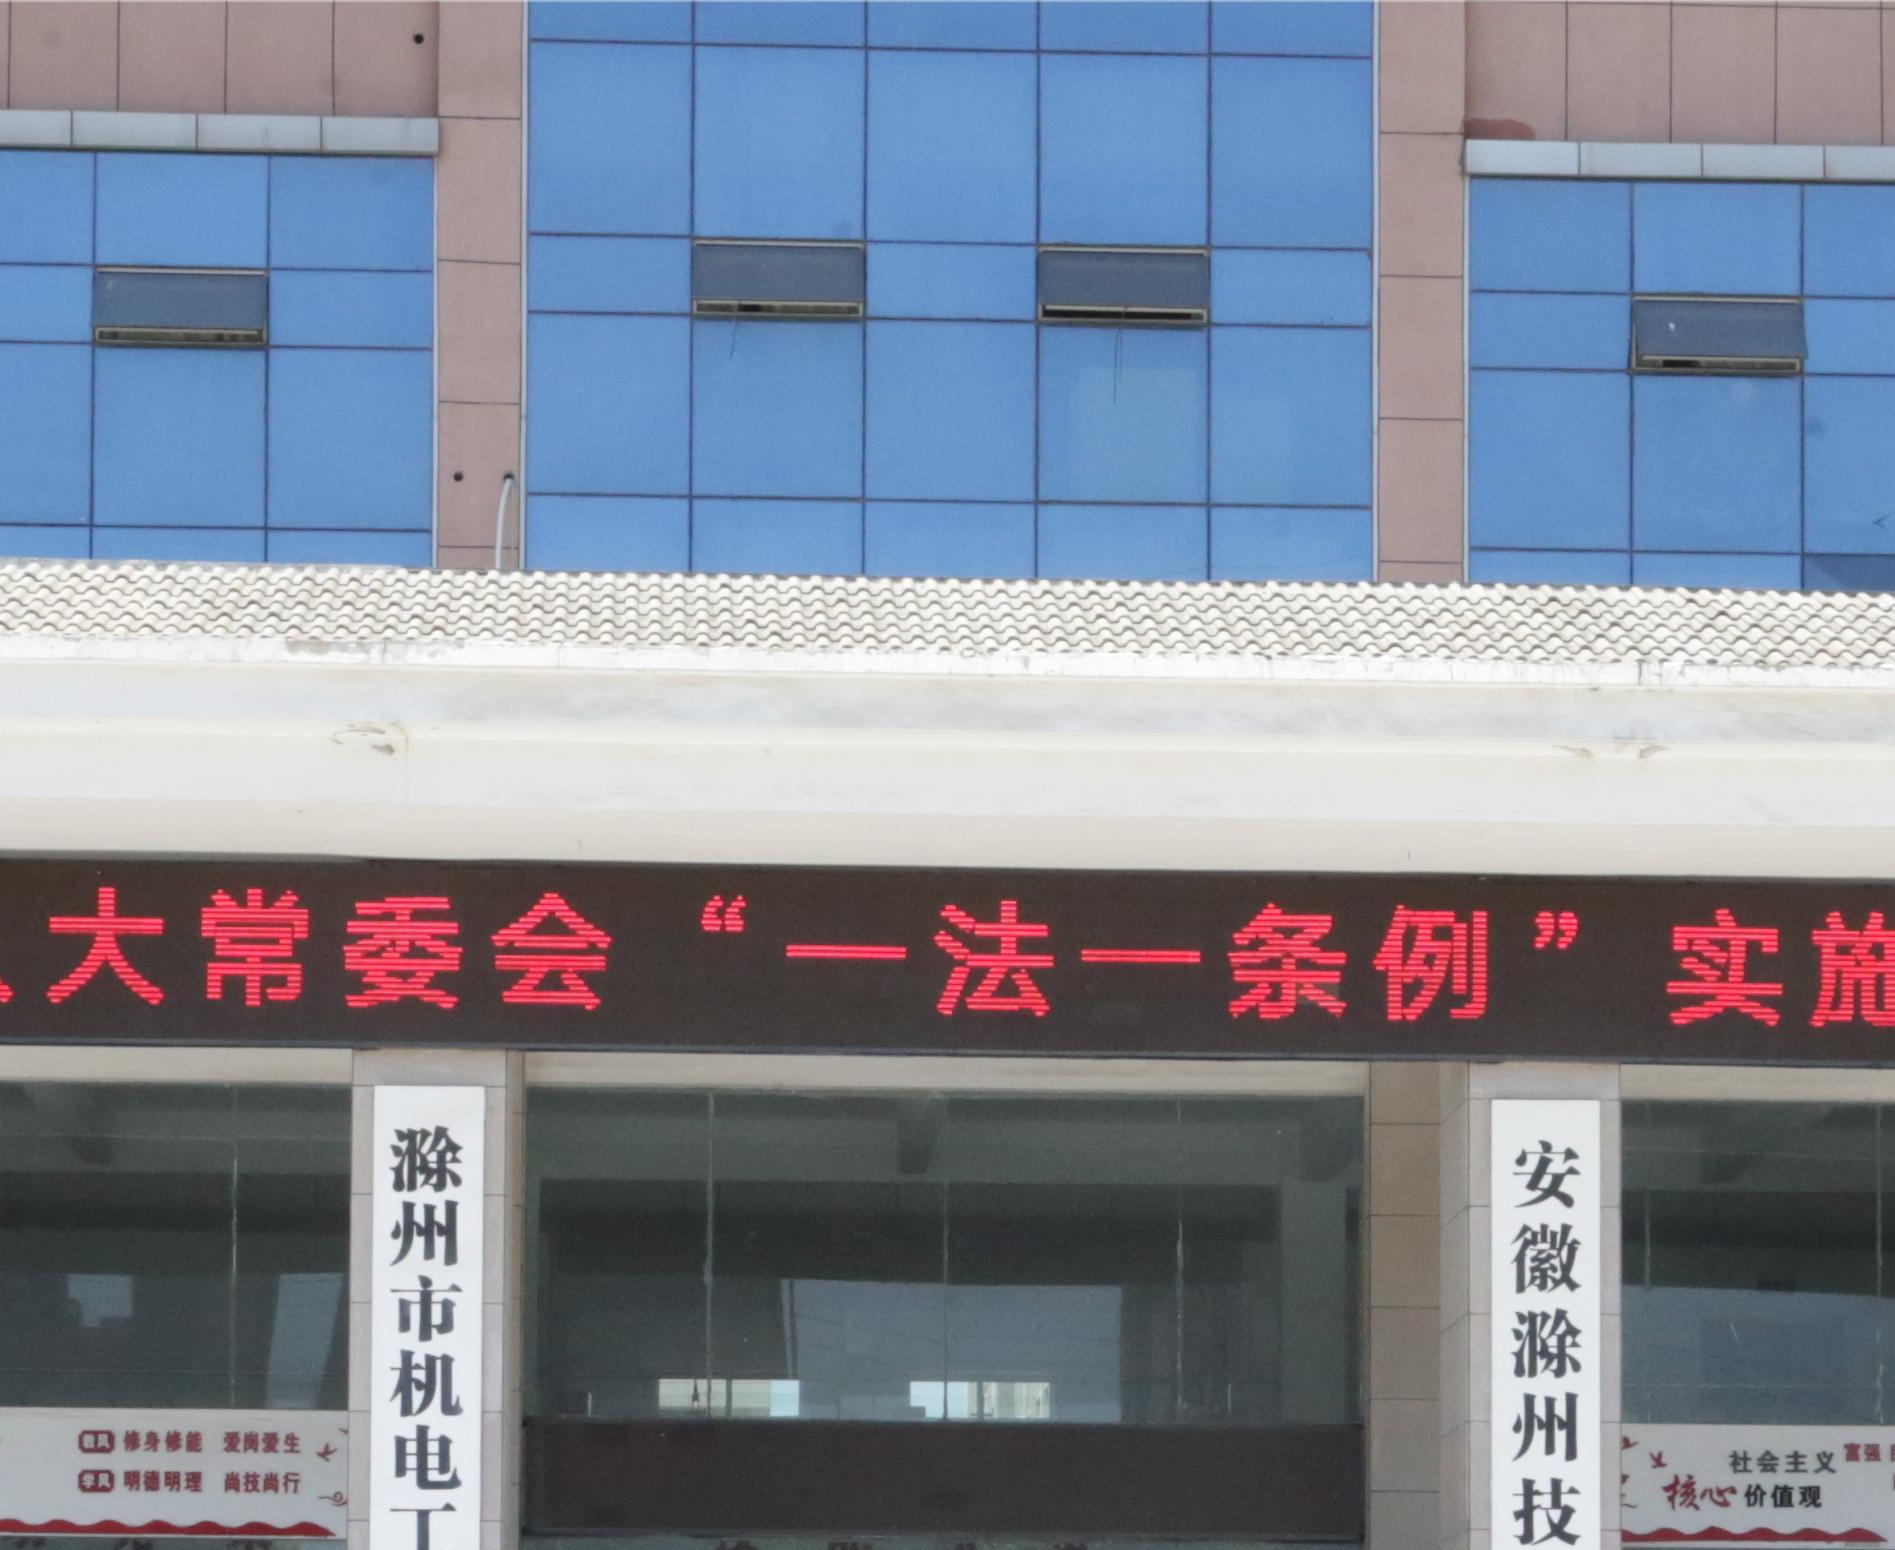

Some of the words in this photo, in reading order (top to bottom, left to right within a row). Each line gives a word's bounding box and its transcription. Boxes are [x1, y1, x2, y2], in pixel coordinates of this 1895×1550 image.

[124, 1430, 203, 1452] 修身修能
[224, 1431, 302, 1453] 爱岗爱生
[1843, 1443, 1882, 1462] 富强
[1728, 1450, 1837, 1474] 社会主义
[124, 1470, 203, 1492] 明德明理
[224, 1471, 302, 1493] 尚技尚行
